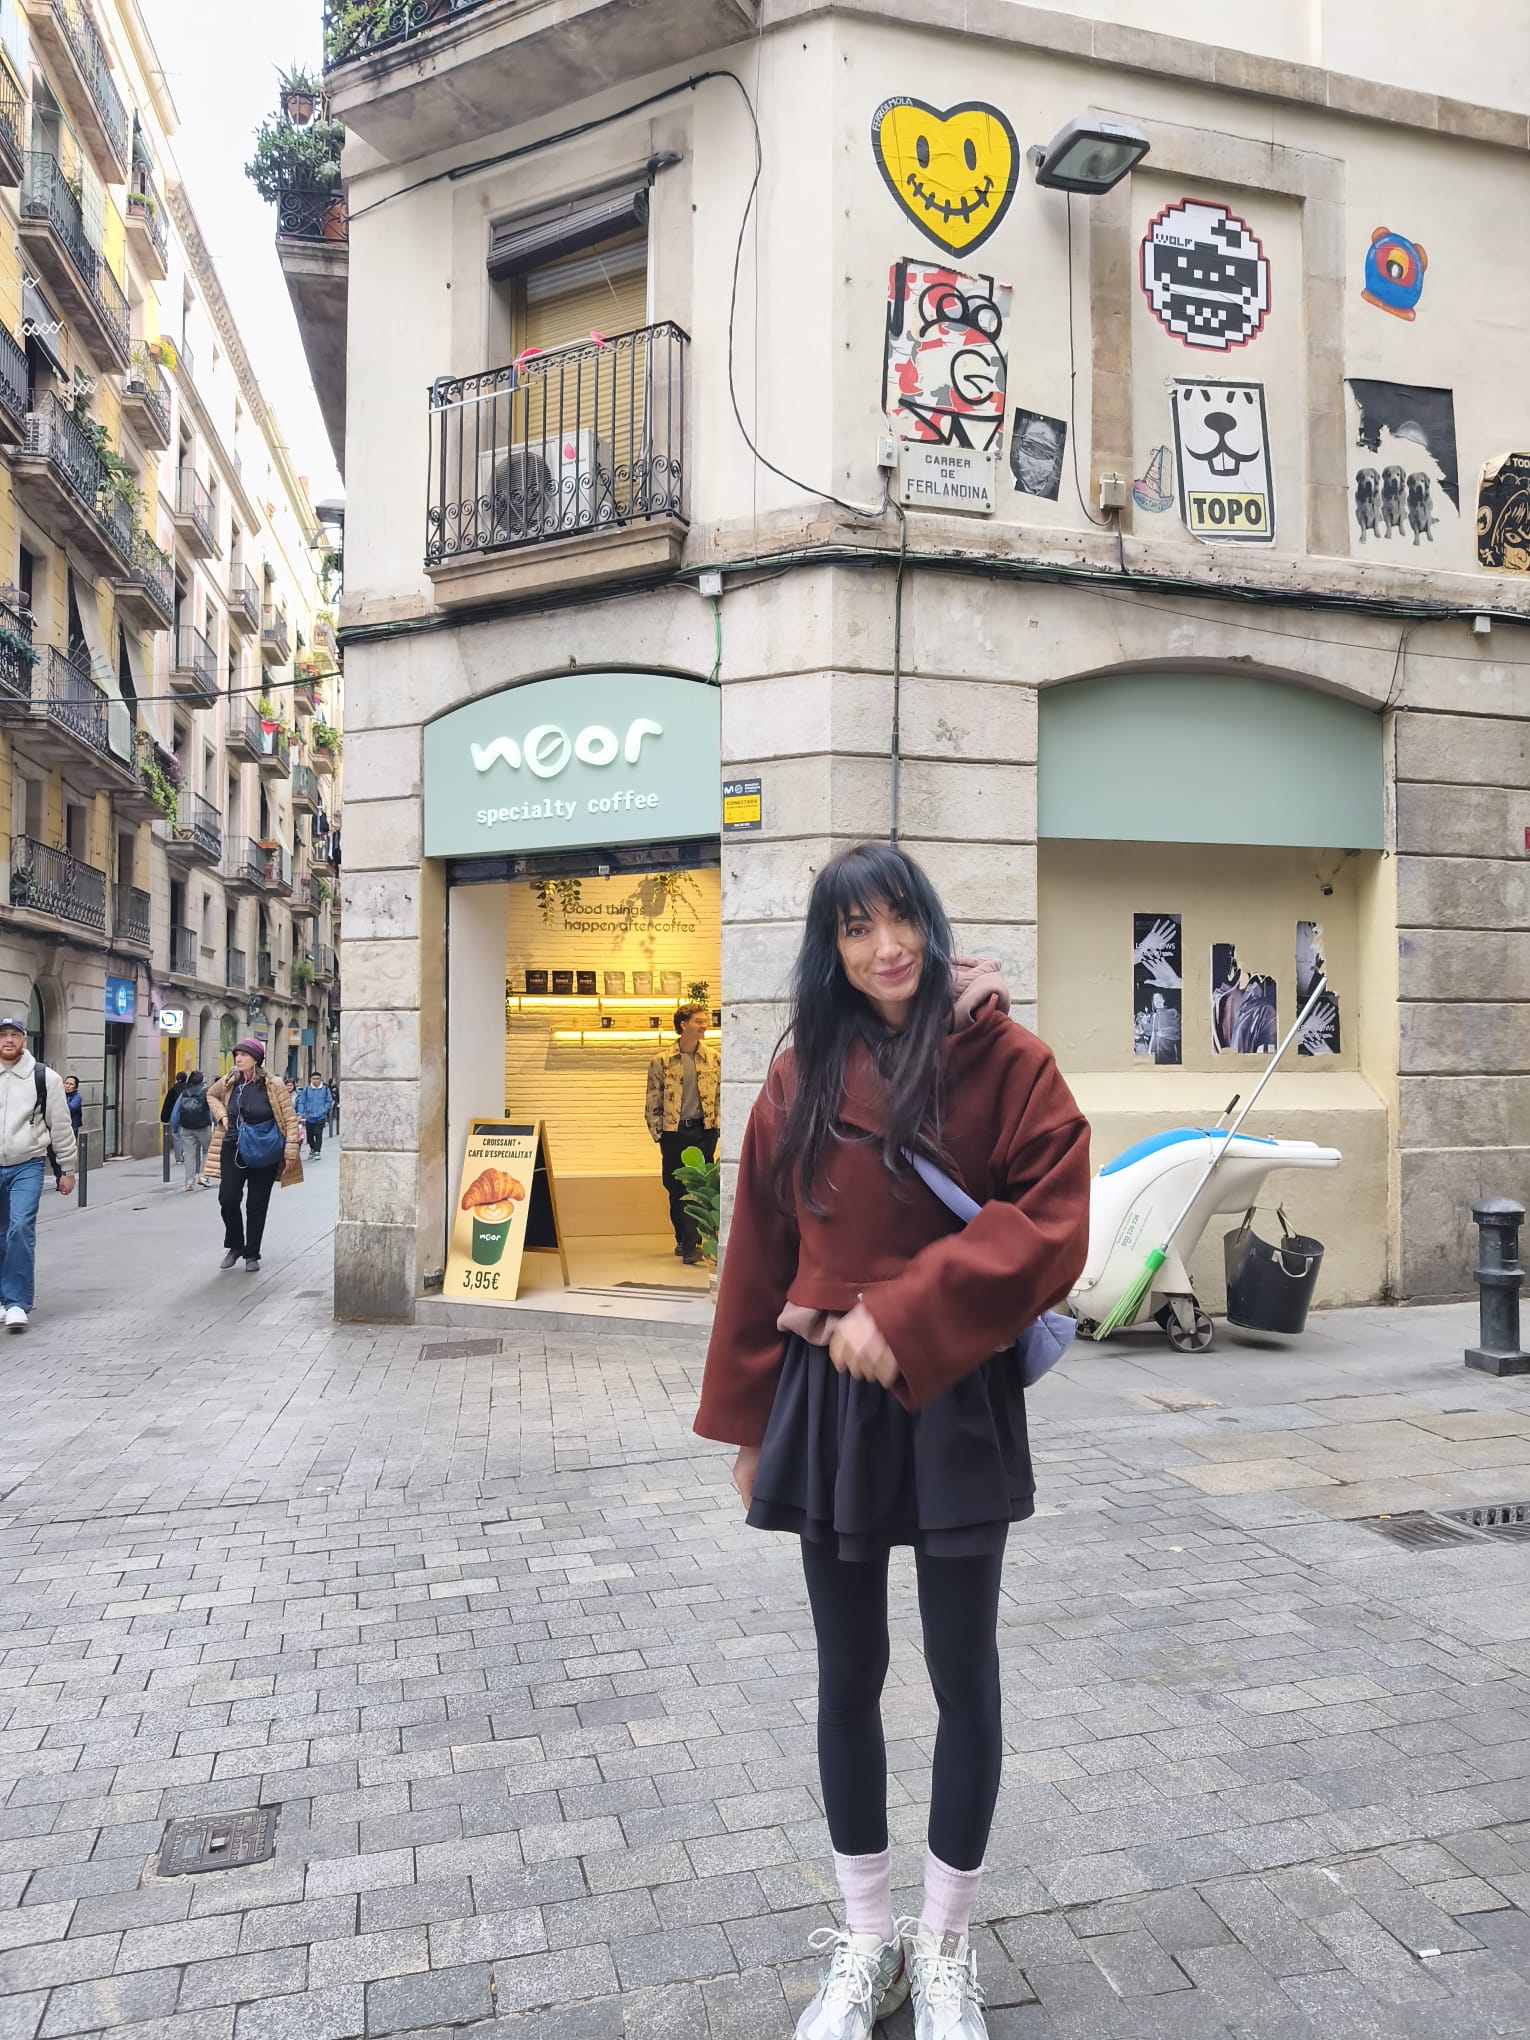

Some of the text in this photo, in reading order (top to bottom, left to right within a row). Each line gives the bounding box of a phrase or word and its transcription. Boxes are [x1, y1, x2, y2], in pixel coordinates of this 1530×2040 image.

[925, 454, 971, 469] CARRER
[940, 468, 956, 479] DE
[907, 478, 989, 500] FERLANDINA
[1192, 497, 1262, 526] TOPO
[476, 789, 660, 829] specialty coffee
[565, 903, 646, 918] Good things
[564, 919, 696, 933] happen after coffee
[482, 1138, 517, 1147] CROISSANT
[484, 1150, 533, 1159] D'ESPECIALITAT
[462, 1269, 501, 1291] 3,95€
